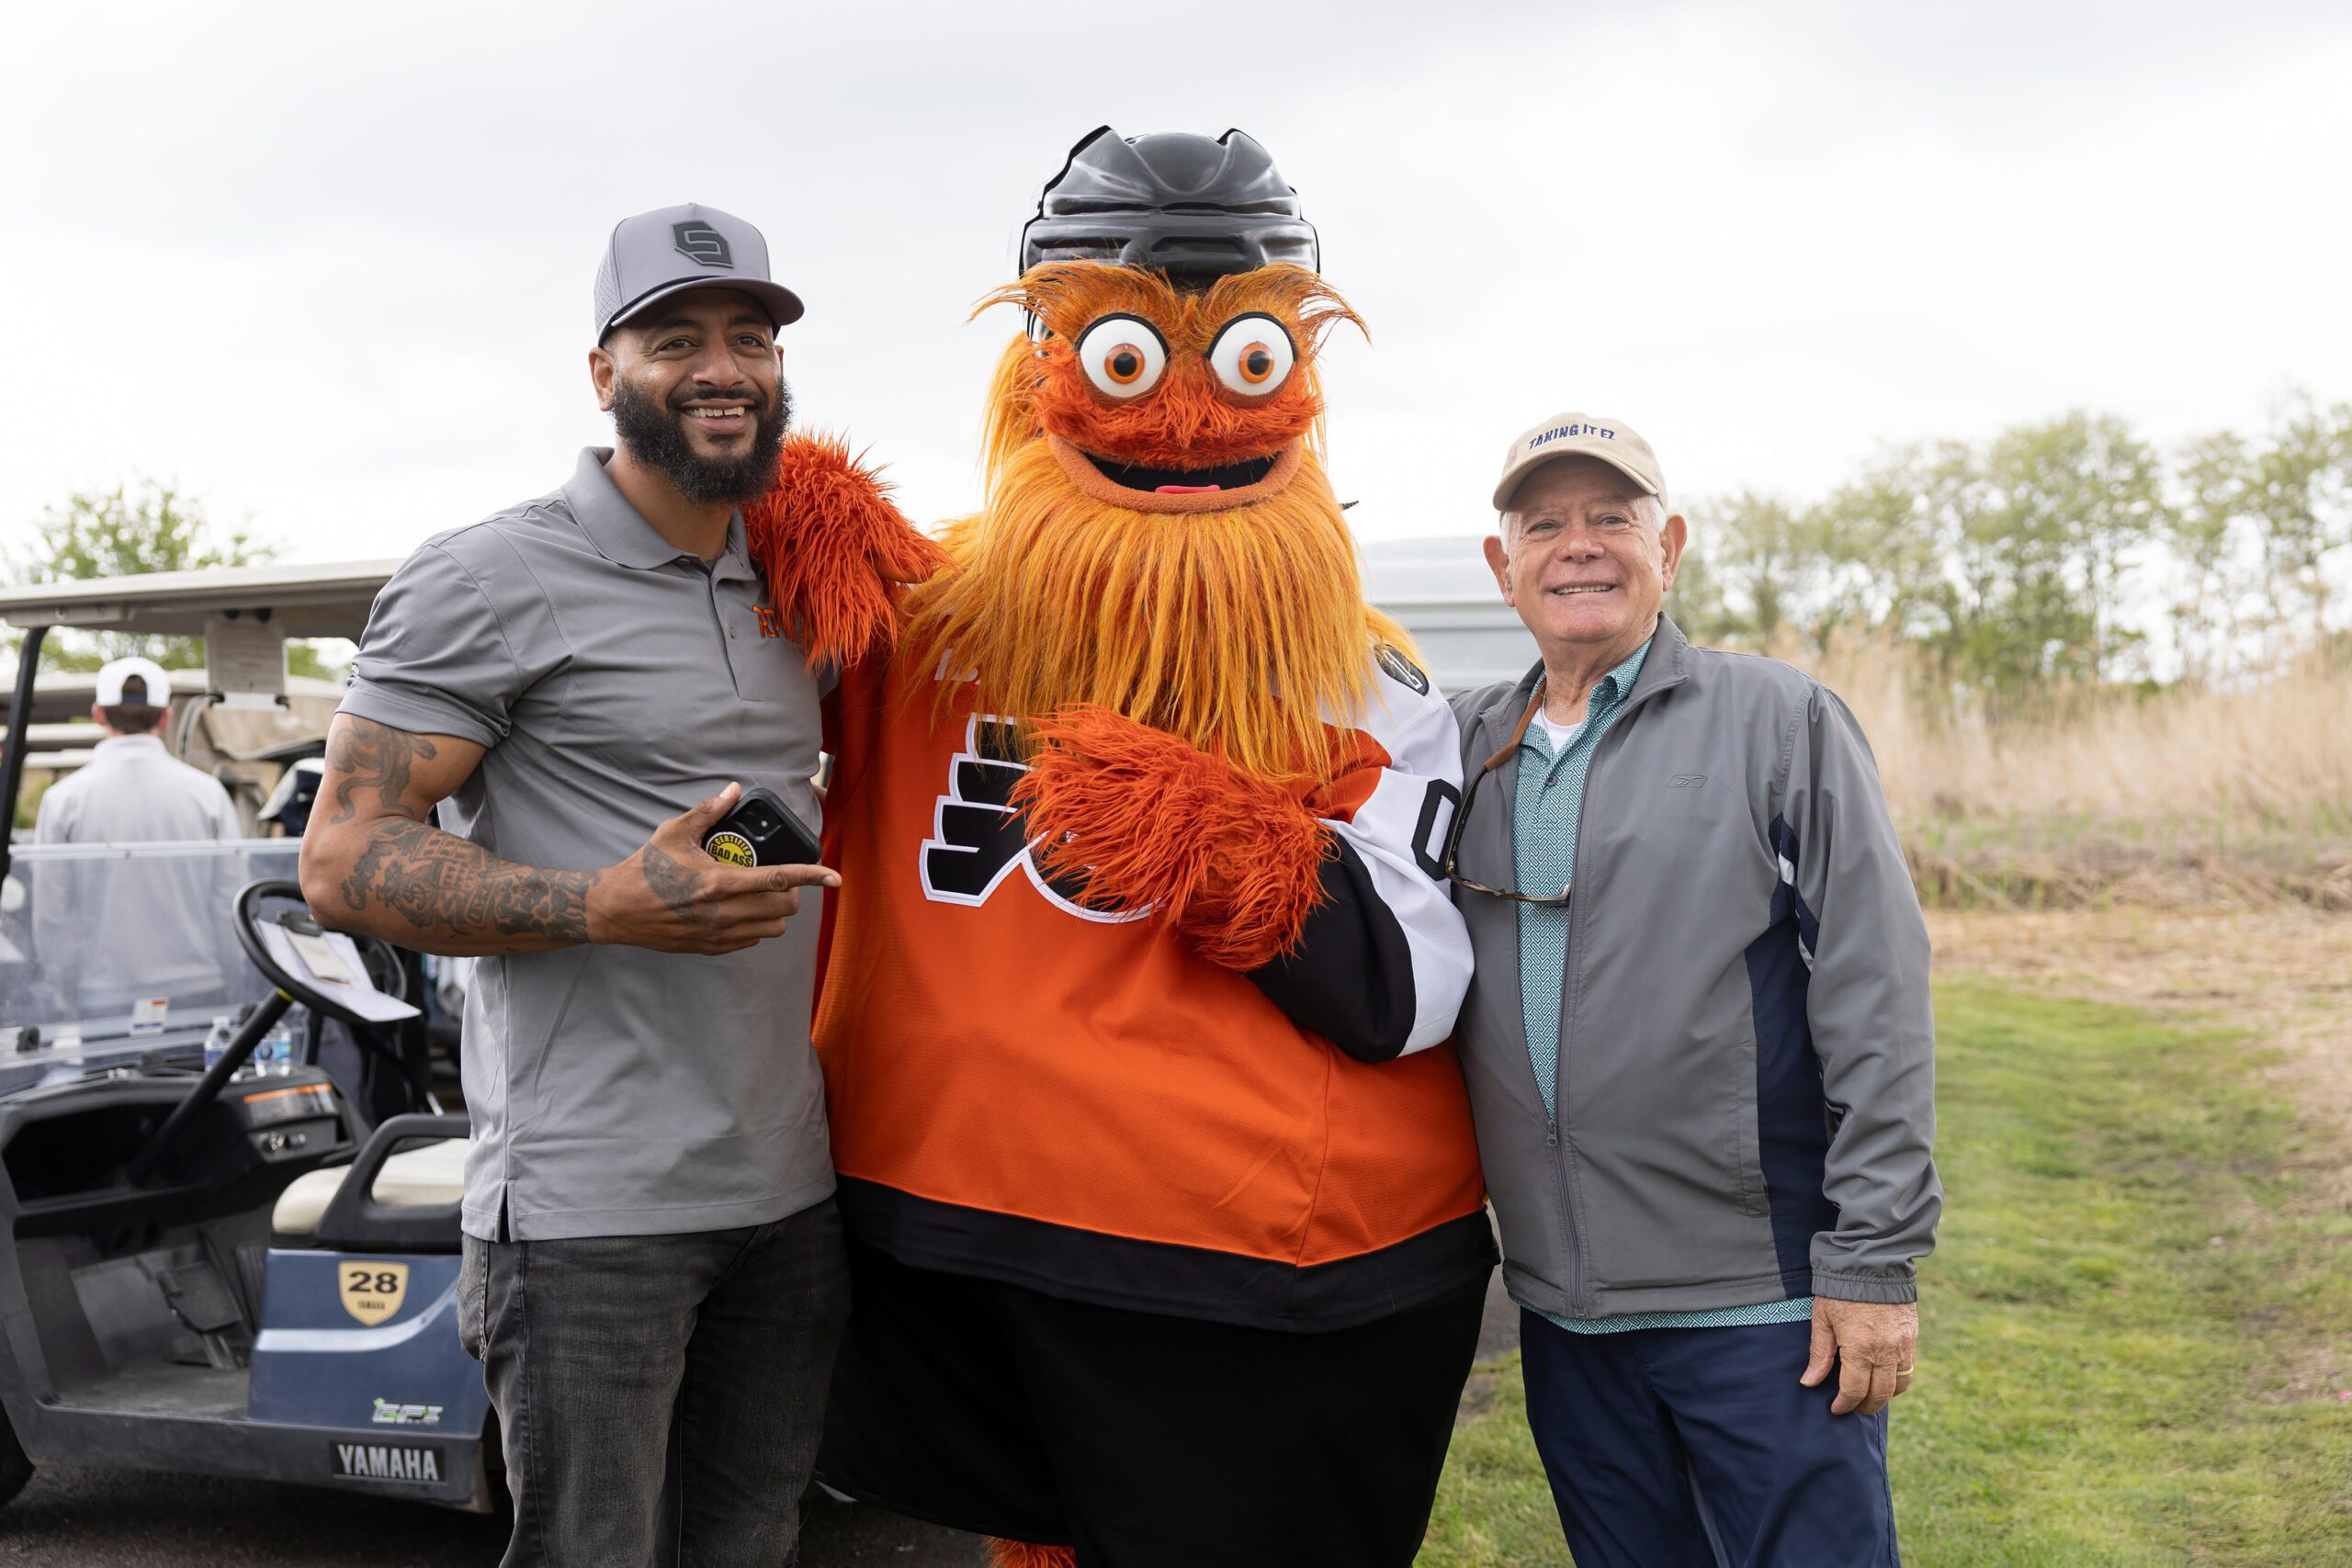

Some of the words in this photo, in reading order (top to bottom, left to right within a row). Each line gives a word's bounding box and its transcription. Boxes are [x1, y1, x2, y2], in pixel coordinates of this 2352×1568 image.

[1528, 423, 1579, 450] TAKING
[1582, 423, 1598, 435] IT
[1600, 428, 1616, 441] EZ
[710, 844, 731, 861] BAD
[731, 852, 752, 868] ASS
[714, 834, 752, 857] CERTIFIED
[348, 1271, 399, 1294] 28
[337, 1443, 440, 1481] YAMAHA
